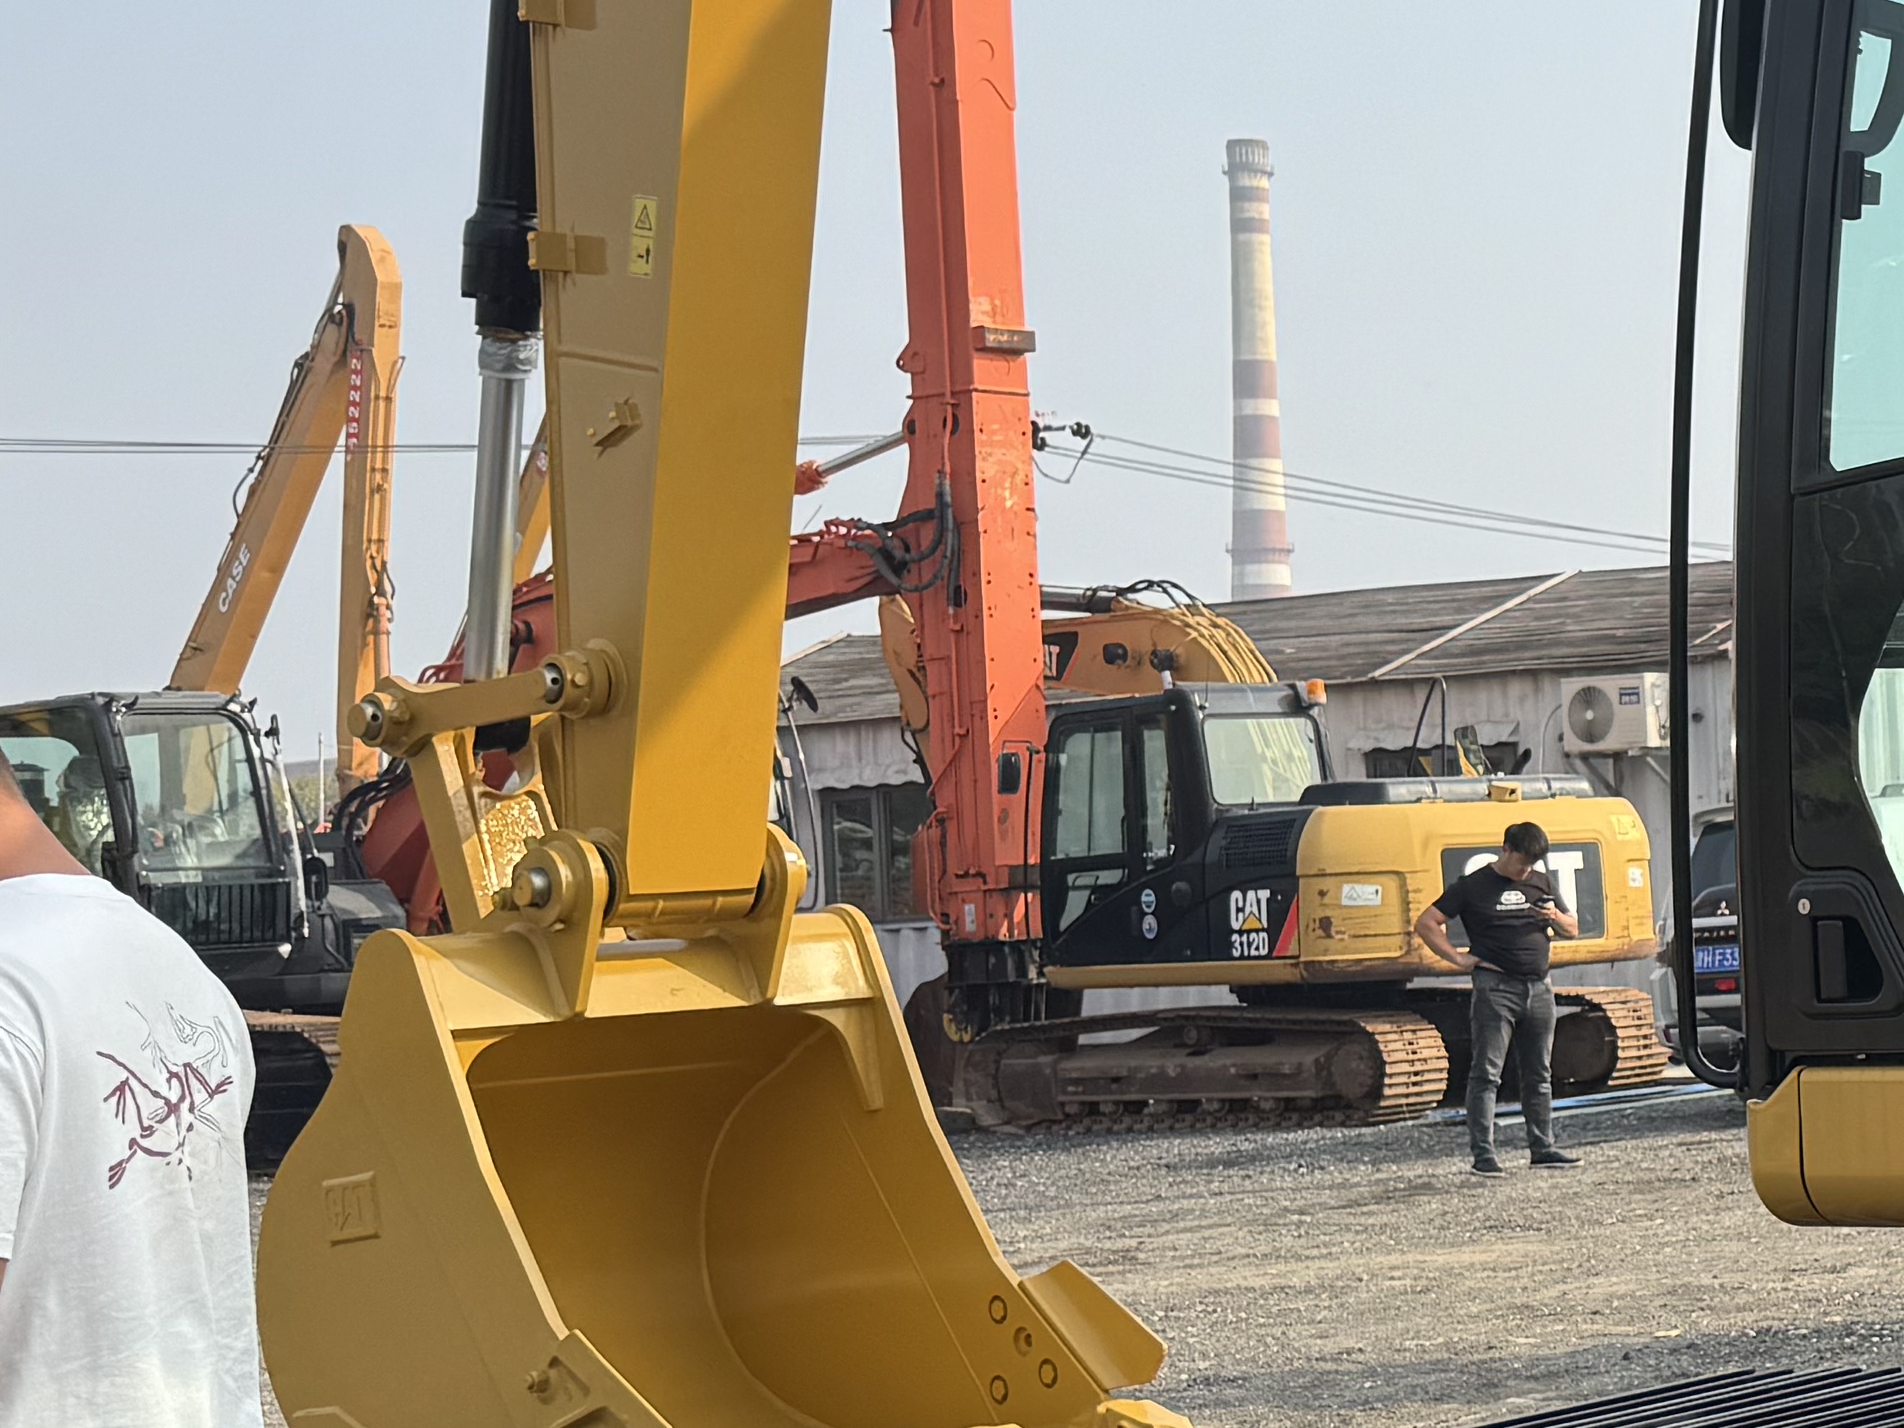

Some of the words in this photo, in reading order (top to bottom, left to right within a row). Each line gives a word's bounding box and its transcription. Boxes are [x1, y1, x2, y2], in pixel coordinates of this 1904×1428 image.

[219, 543, 251, 613] CASE
[1230, 888, 1271, 931] CAT
[1230, 932, 1270, 958] 312D
